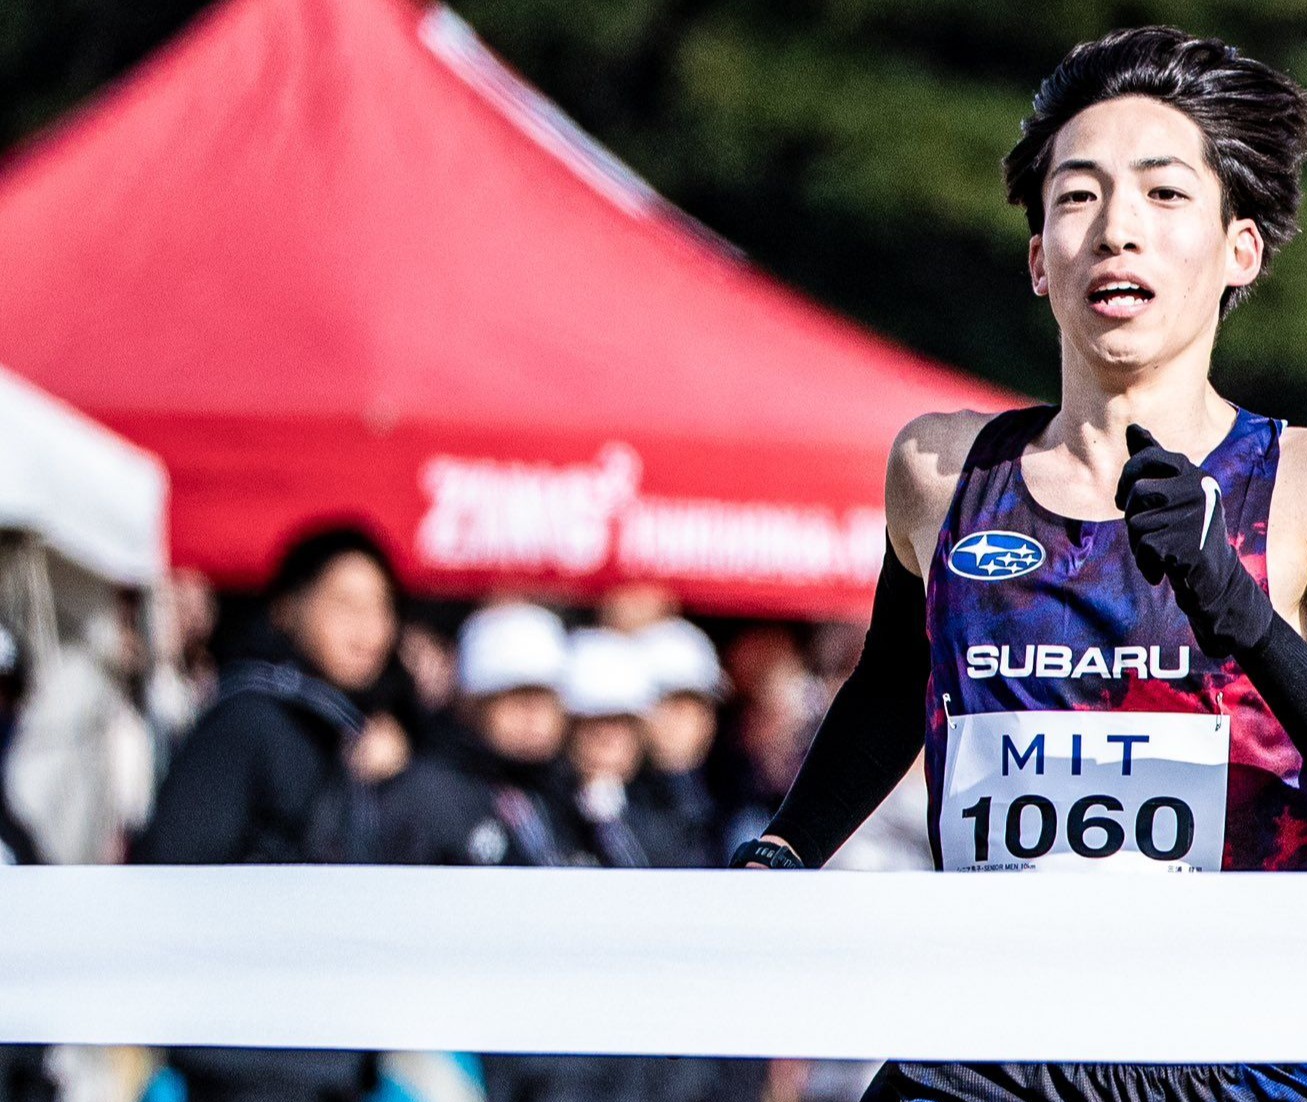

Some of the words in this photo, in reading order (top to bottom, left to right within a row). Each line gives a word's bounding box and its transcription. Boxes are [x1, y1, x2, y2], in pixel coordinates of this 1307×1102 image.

[966, 644, 1190, 680] SUBARU
[1001, 733, 1150, 777] MIT
[961, 794, 1195, 862] 1060
